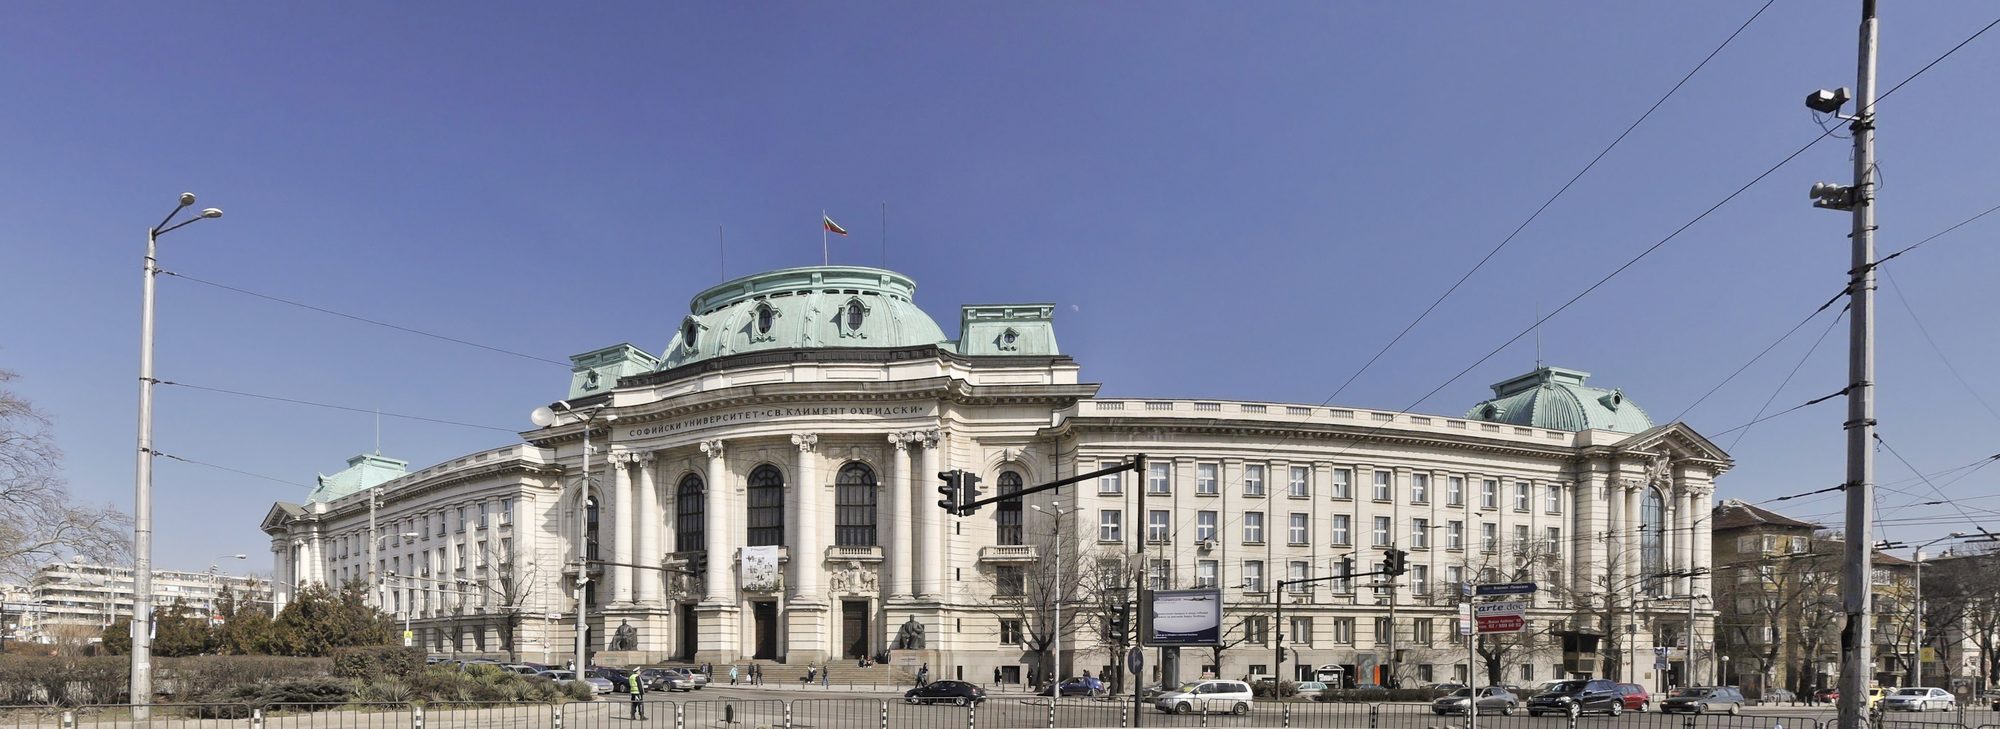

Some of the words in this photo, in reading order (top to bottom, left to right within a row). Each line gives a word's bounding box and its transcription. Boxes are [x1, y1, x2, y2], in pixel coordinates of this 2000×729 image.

[630, 423, 681, 437] СОФИЙСКИ
[684, 411, 758, 427] УНИВЕРСИТЕТ
[766, 409, 784, 417] СВ.
[786, 407, 845, 415] КЛИМЕНТ
[850, 406, 918, 415] ОХРИДСКИ
[1506, 603, 1524, 611] doc
